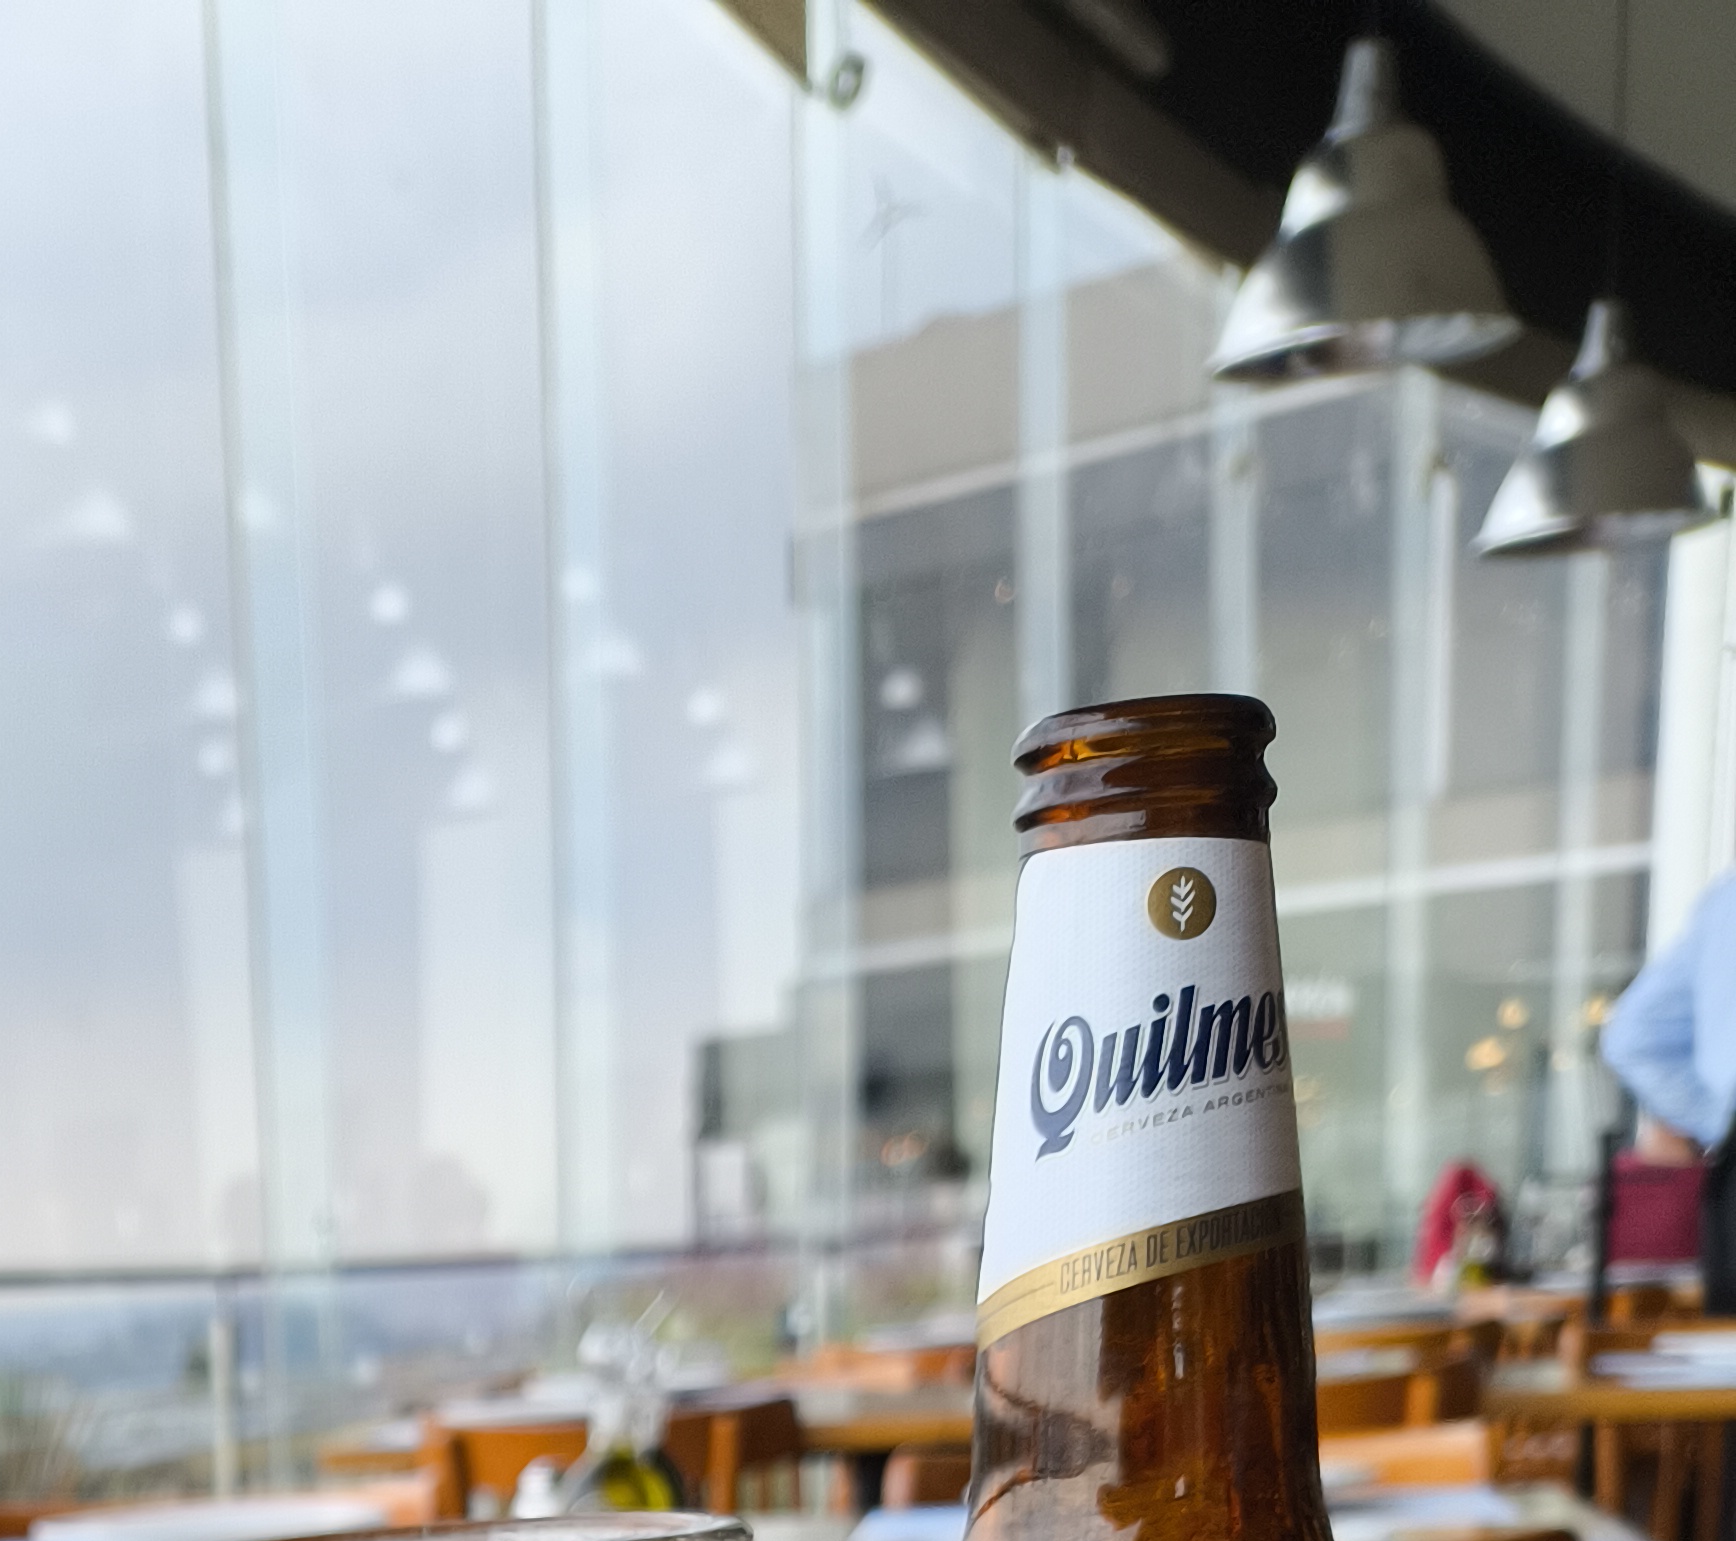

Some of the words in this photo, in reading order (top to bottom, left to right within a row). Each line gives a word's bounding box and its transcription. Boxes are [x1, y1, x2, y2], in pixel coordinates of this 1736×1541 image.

[1091, 1105, 1194, 1147] CERVEZA
[1060, 1240, 1138, 1295] CERVEZA
[1146, 1229, 1170, 1269] DE
